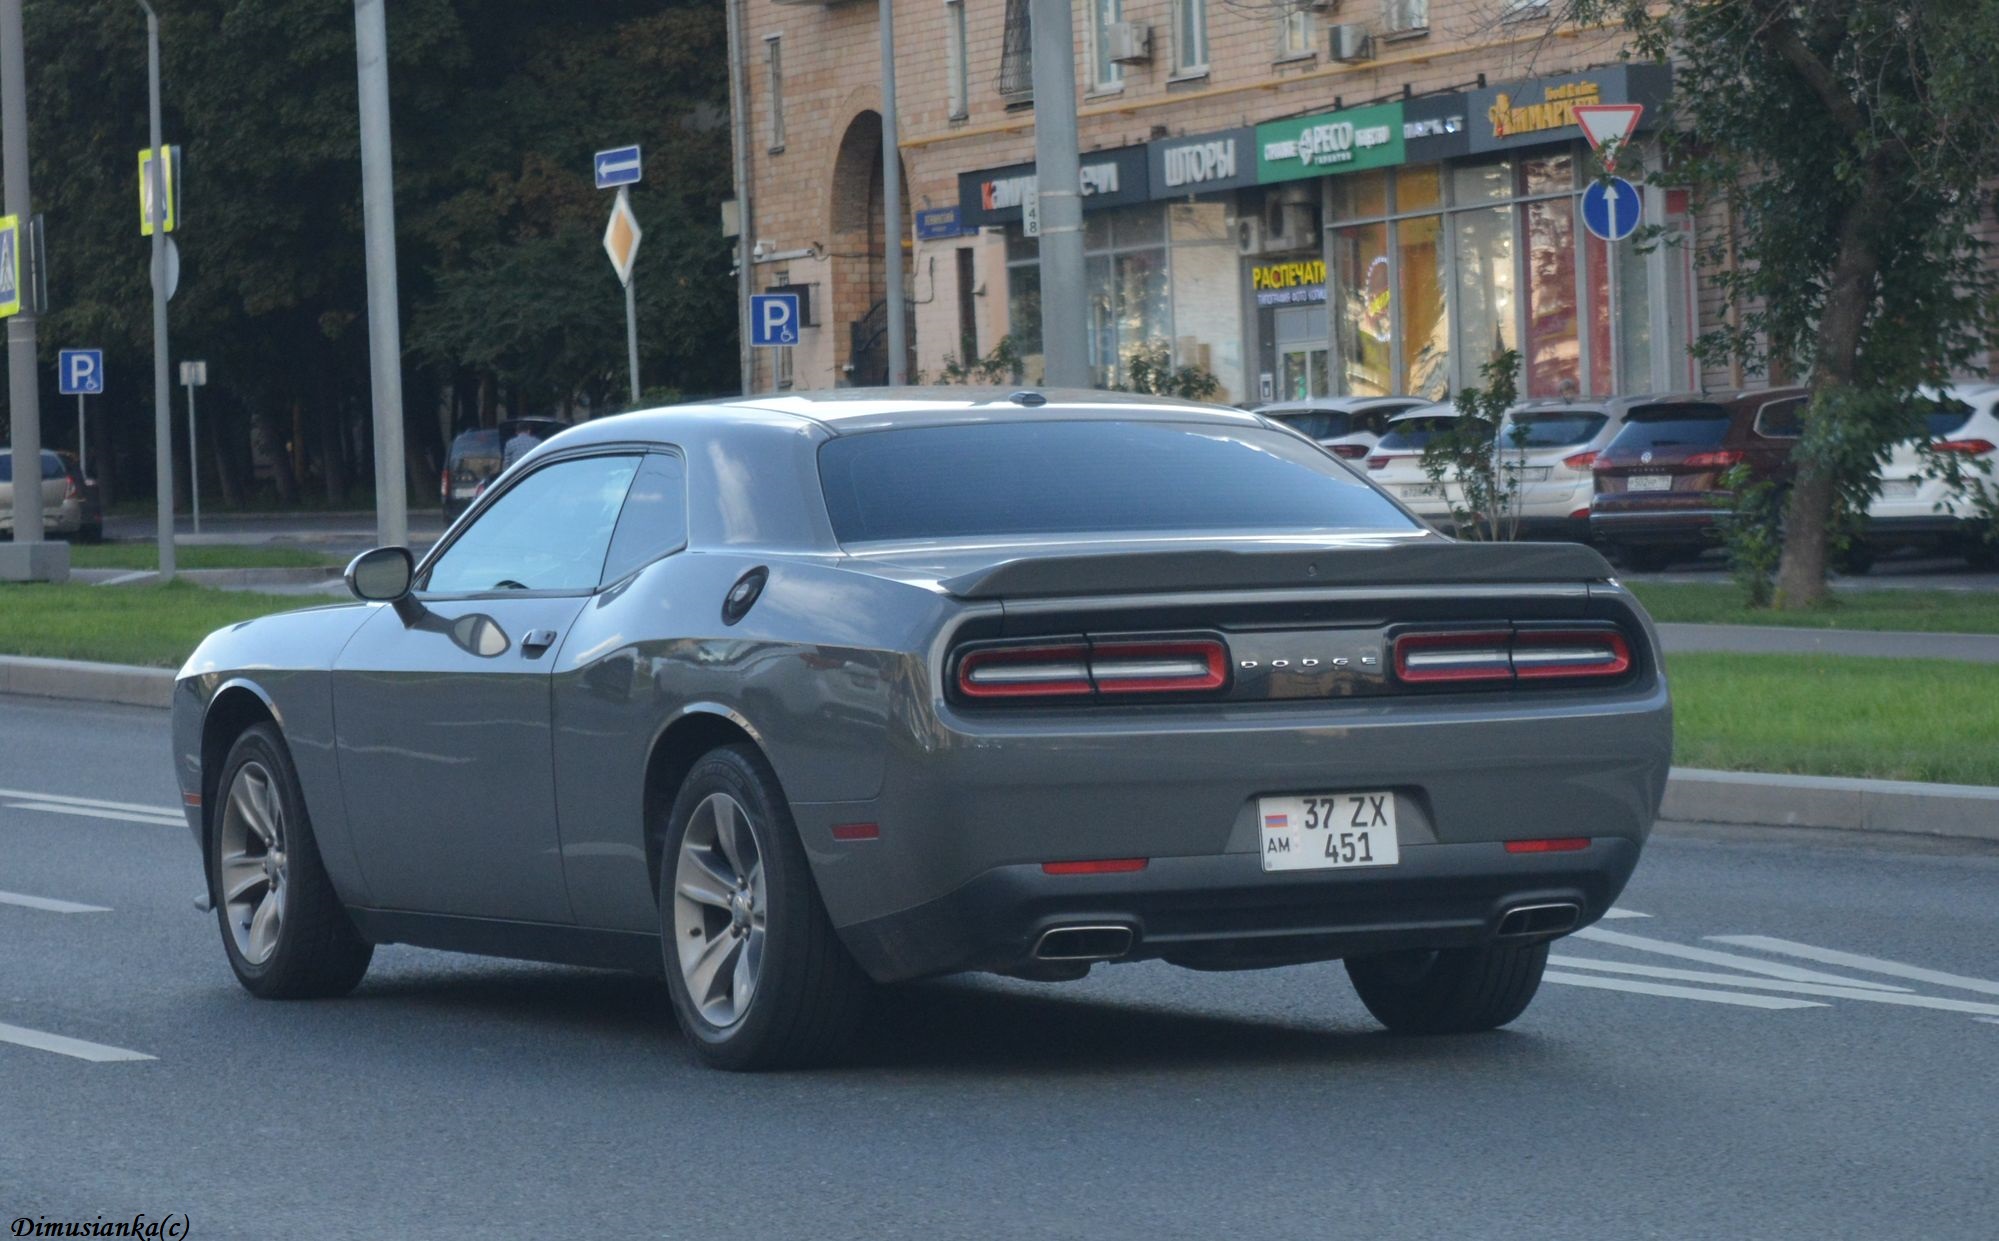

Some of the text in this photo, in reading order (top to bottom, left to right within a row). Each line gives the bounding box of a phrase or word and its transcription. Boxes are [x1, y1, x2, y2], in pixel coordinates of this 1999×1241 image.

[1313, 121, 1354, 155] РЕСО
[1403, 115, 1463, 140] ПАРКТ
[1164, 138, 1236, 187] ШТОРЫ
[763, 300, 790, 341] P
[71, 354, 95, 389] P
[1240, 656, 1377, 669] DODGE
[1303, 796, 1388, 830] 37 ZX
[1267, 837, 1290, 854] AM
[1324, 831, 1374, 864] 451
